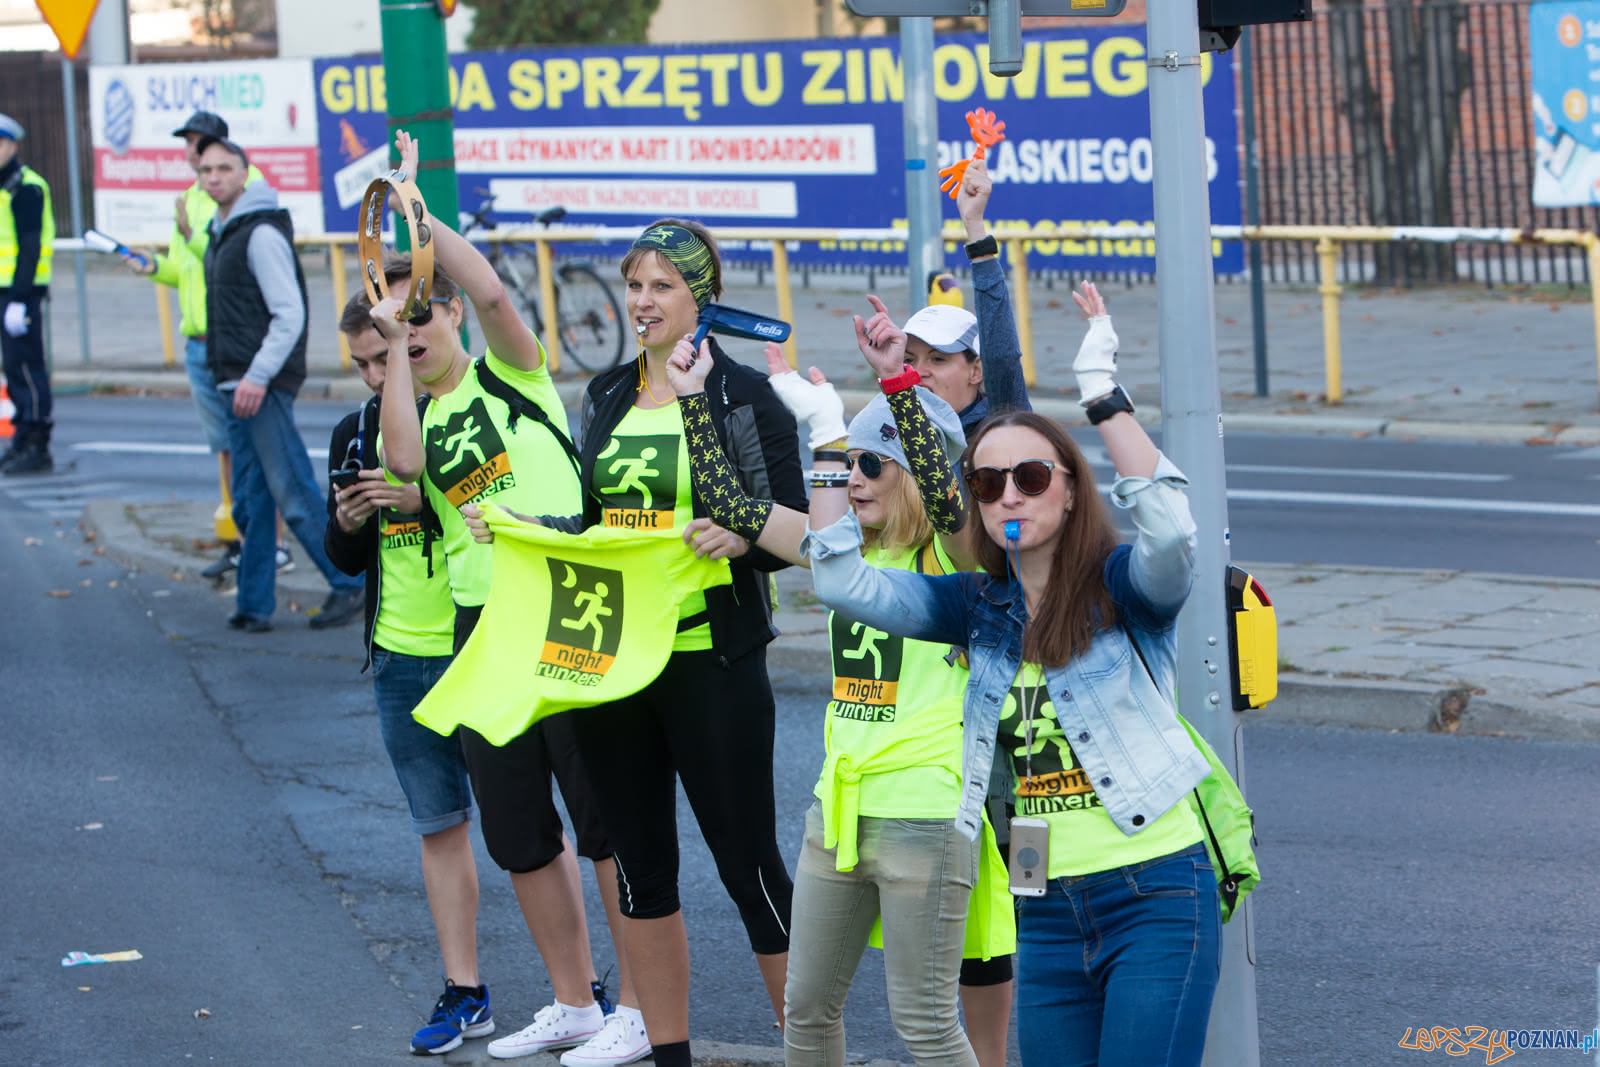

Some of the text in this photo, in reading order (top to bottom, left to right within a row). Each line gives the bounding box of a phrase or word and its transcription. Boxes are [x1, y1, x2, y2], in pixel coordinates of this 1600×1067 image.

[320, 36, 1213, 121] GIEA SPRZĘTU ZIMOWEG
[620, 137, 669, 162] NART
[753, 322, 783, 336] hella
[459, 460, 498, 496] night
[608, 509, 658, 528] night
[557, 647, 603, 670] night
[535, 661, 604, 687] runners
[846, 679, 884, 702] night
[833, 699, 895, 722] unners
[1021, 791, 1104, 816] unner
